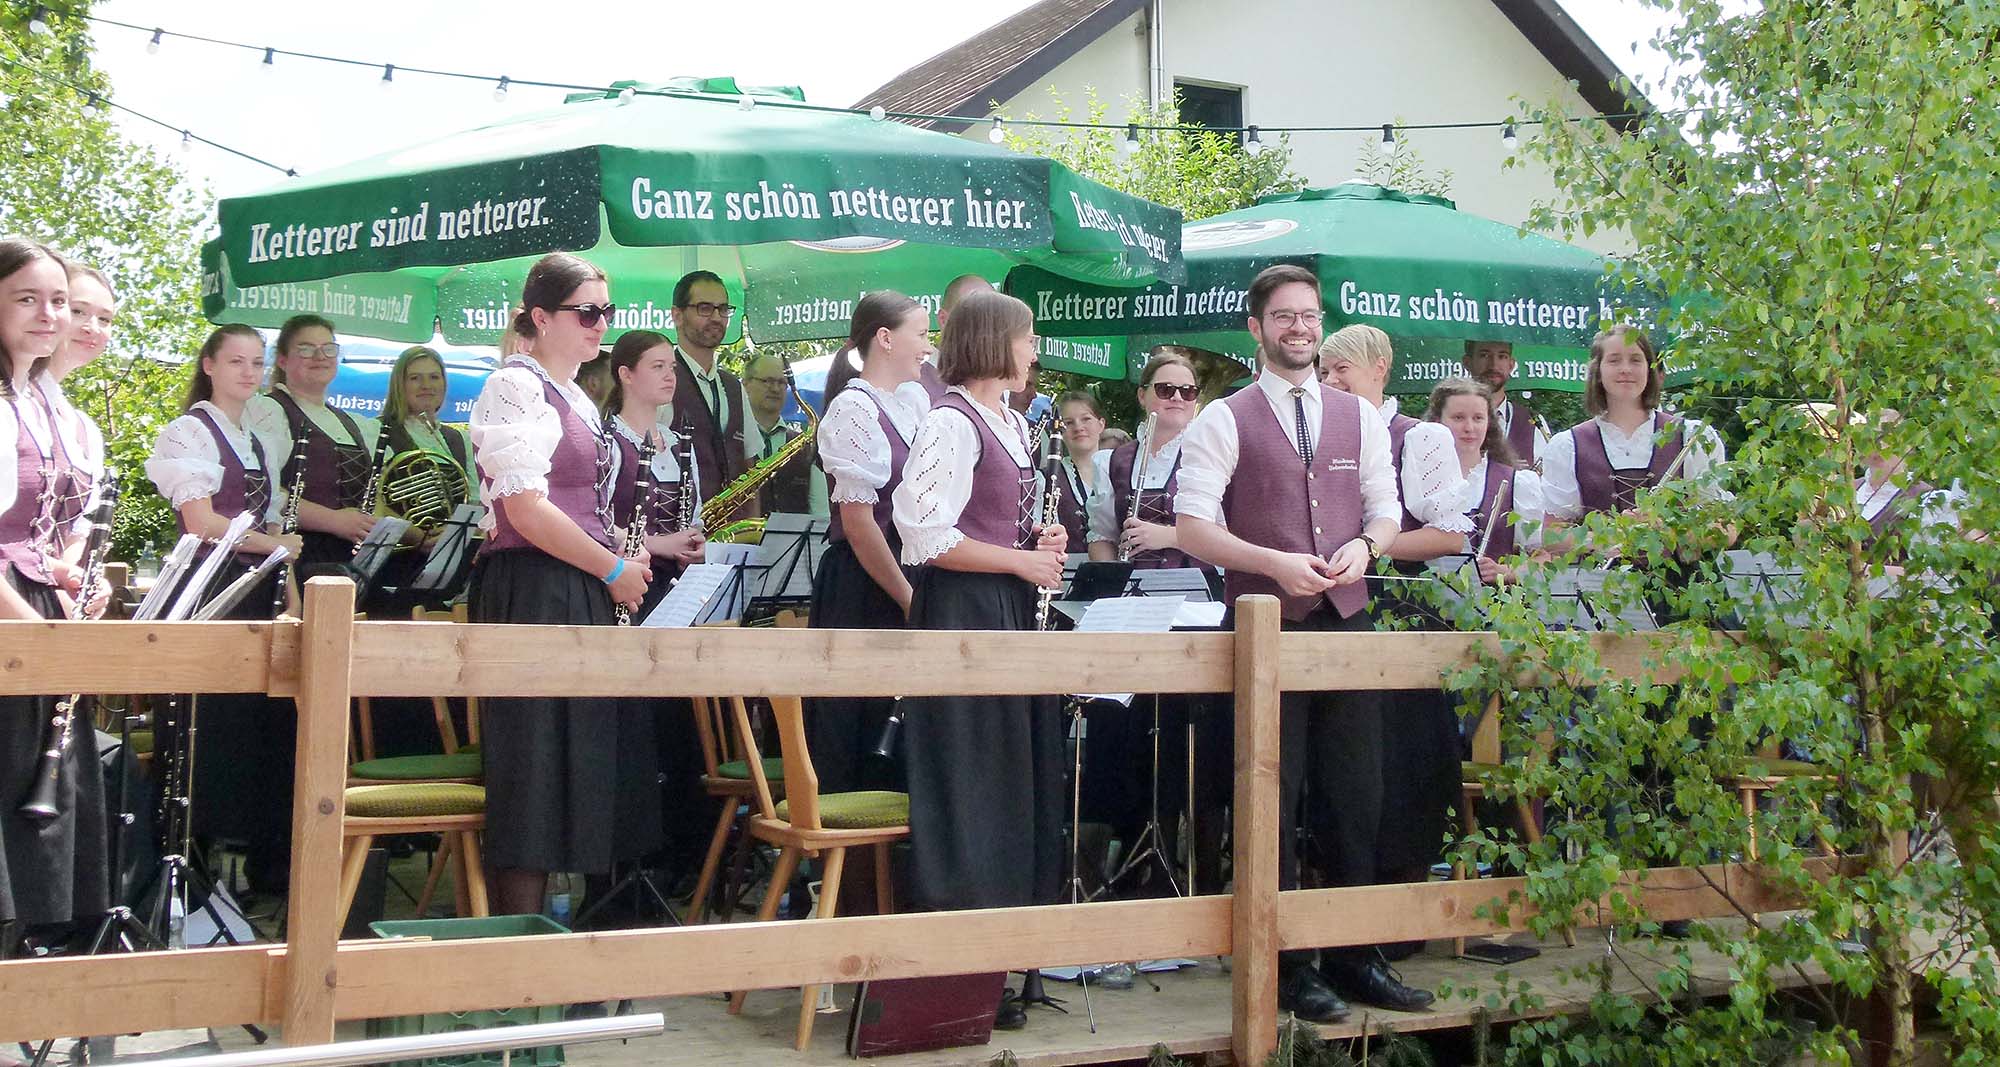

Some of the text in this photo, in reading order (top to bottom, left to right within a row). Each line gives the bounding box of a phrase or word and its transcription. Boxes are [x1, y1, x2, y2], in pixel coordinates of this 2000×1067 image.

[632, 176, 1032, 229] Ganz schön netterer hier.
[248, 196, 550, 263] Ketterer sind netterer.
[1037, 285, 1249, 321] Ketterer sind netter
[1340, 281, 1401, 317] Ganz
[1409, 288, 1479, 323] schön
[1487, 298, 1589, 329] netterer
